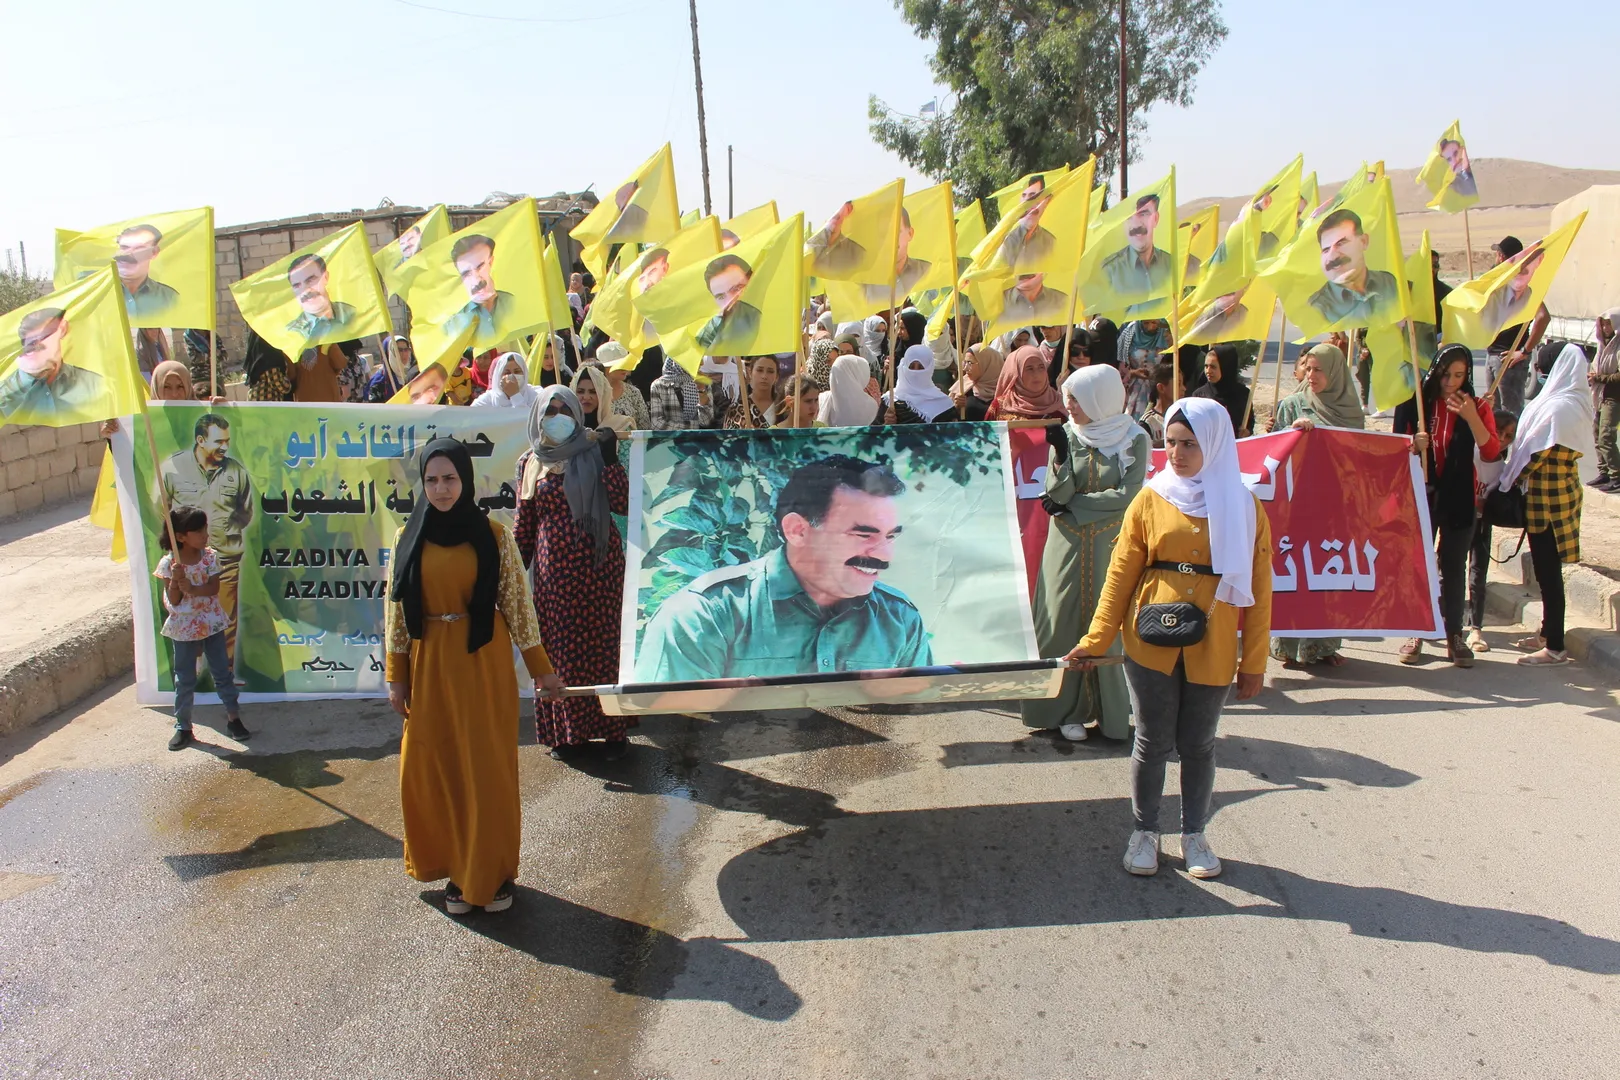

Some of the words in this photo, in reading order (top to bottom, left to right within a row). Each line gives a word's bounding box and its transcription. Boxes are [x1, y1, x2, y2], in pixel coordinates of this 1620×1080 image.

[284, 417, 328, 468] آبو
[336, 422, 415, 460] القائد
[261, 479, 376, 523] الشعوب
[260, 548, 371, 568] AZADIYA
[1272, 535, 1379, 592] للقائ
